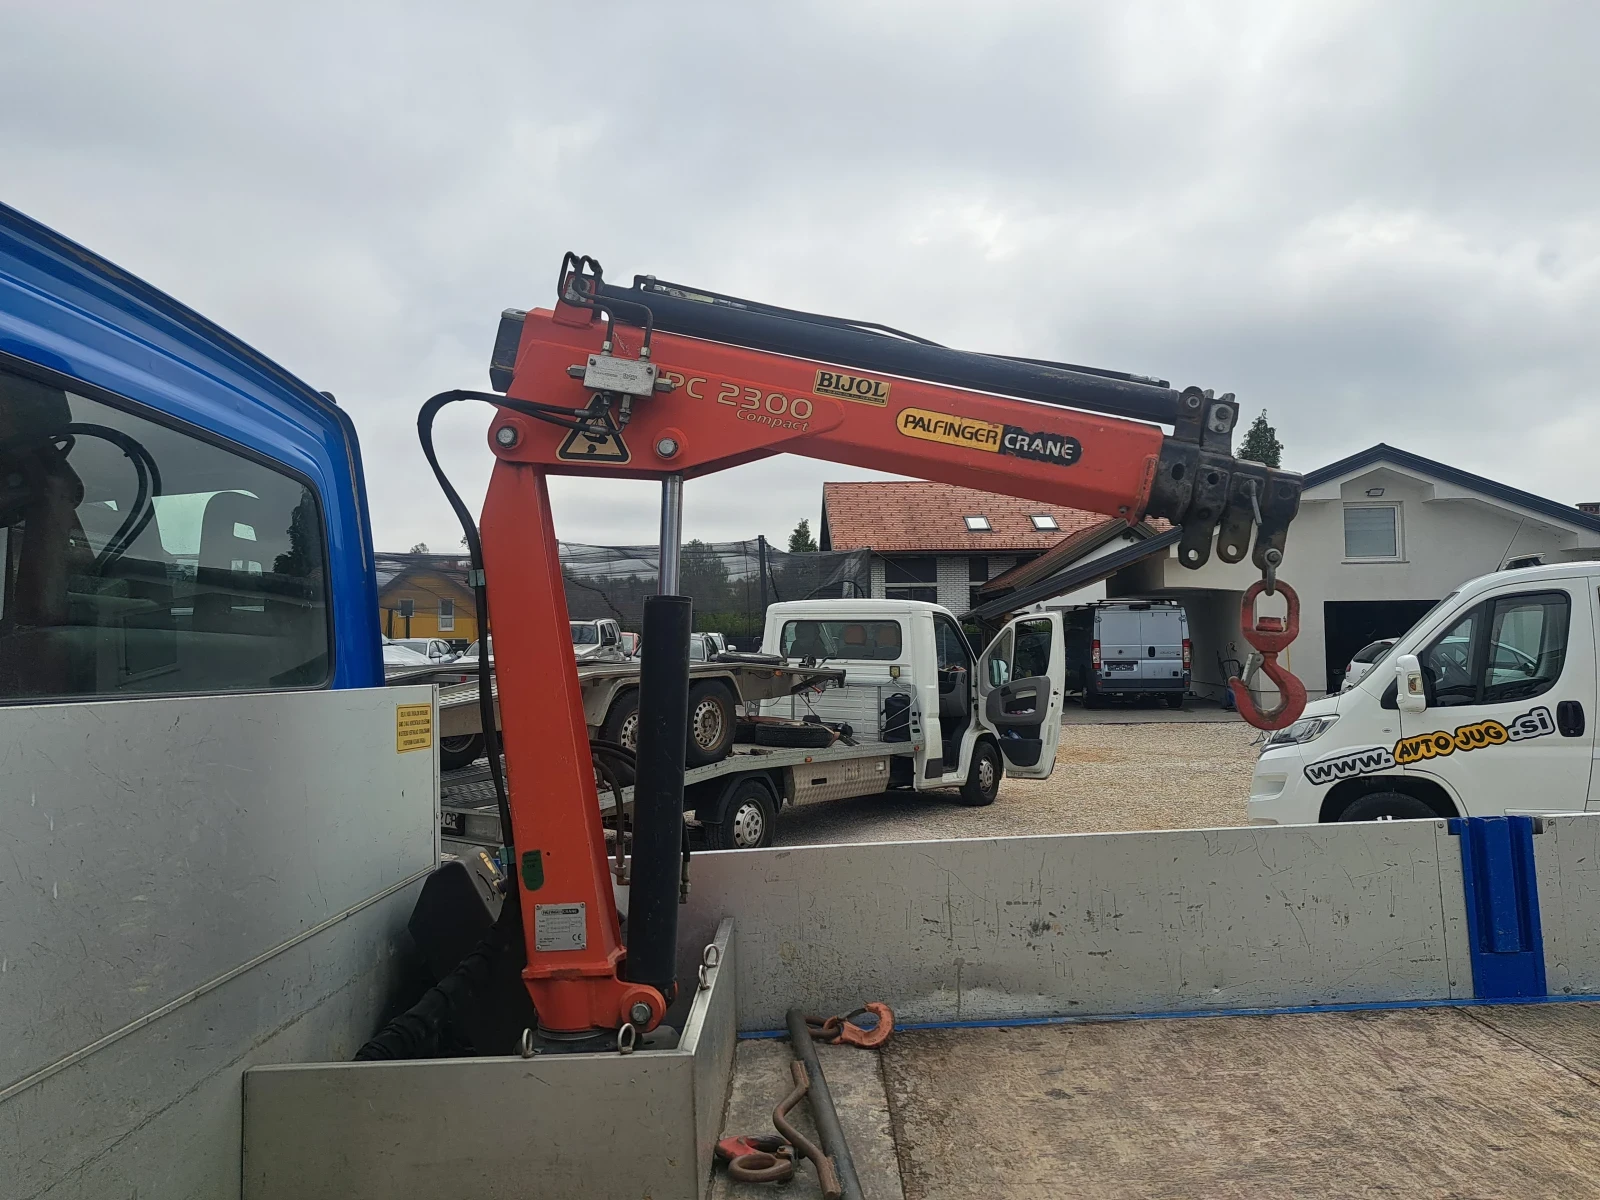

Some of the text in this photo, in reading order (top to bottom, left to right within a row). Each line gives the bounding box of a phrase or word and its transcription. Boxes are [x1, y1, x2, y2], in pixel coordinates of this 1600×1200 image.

[664, 371, 708, 400] PC
[716, 381, 814, 420] 2300
[817, 371, 887, 398] BIJOL
[735, 408, 810, 432] Compact
[902, 413, 1075, 460] PALFINGER CRANE
